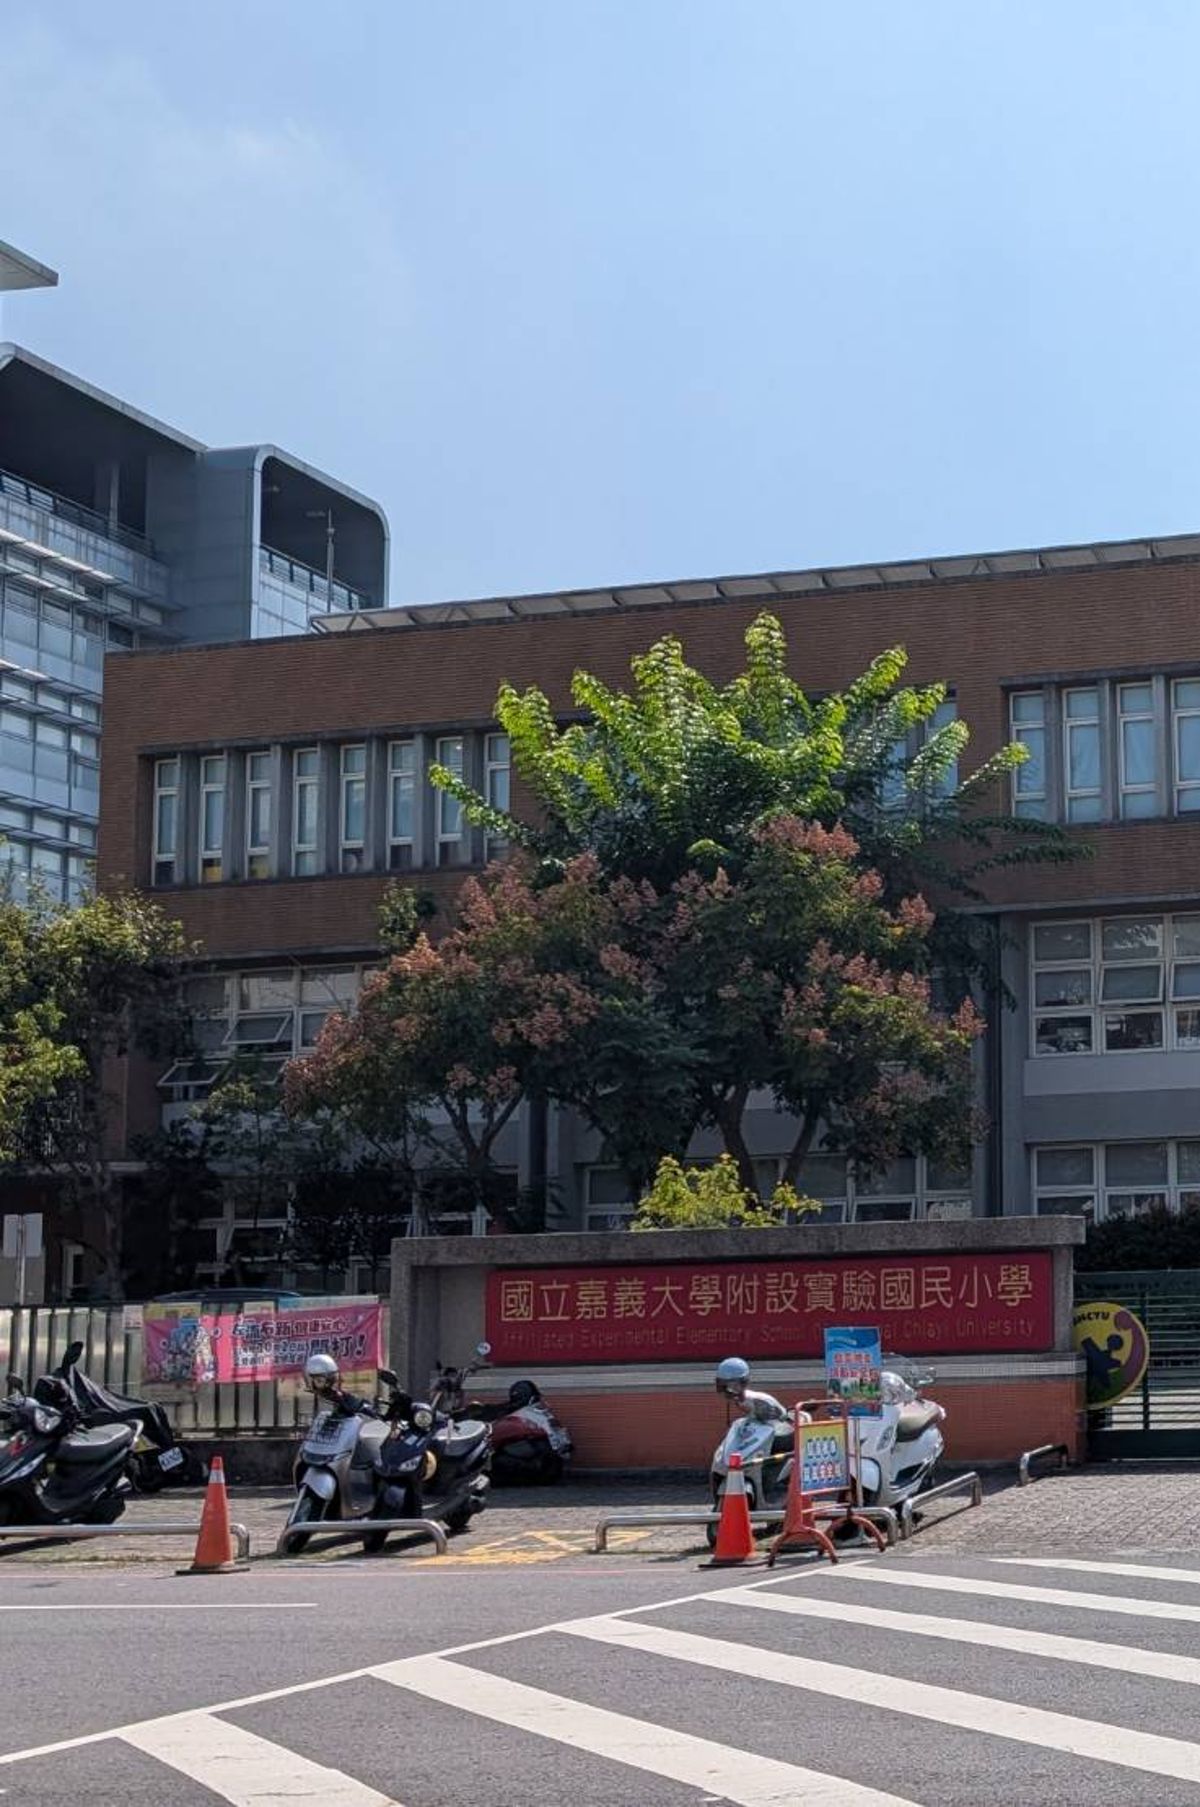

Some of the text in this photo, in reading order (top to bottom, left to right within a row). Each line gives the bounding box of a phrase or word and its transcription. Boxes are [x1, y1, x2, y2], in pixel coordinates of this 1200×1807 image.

[501, 1264, 1033, 1322] 國立嘉義大學附設實驗國民小學
